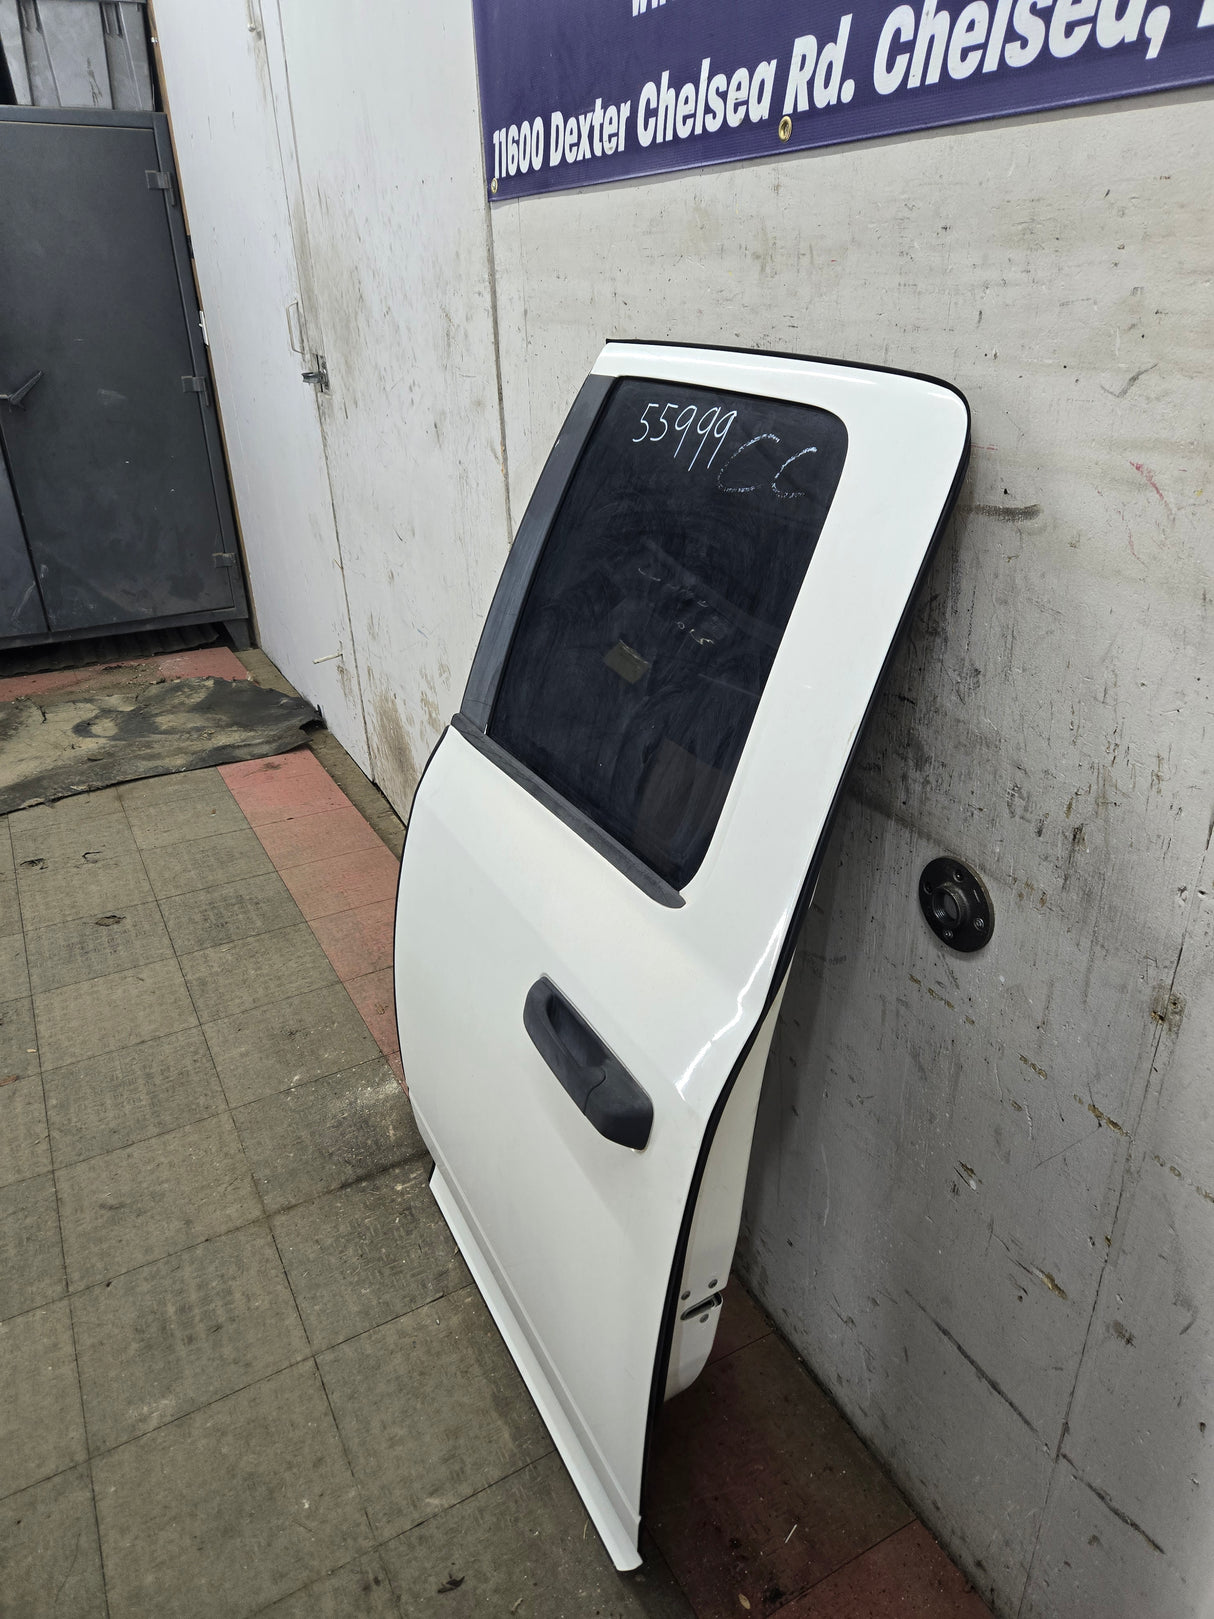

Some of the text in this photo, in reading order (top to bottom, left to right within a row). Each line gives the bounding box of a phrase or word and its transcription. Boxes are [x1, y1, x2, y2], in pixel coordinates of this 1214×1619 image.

[492, 115, 545, 179] 11600
[549, 97, 631, 168] Dexter
[637, 57, 778, 148] Chelsea
[782, 14, 854, 116] Rd.
[632, 402, 738, 472] 55999
